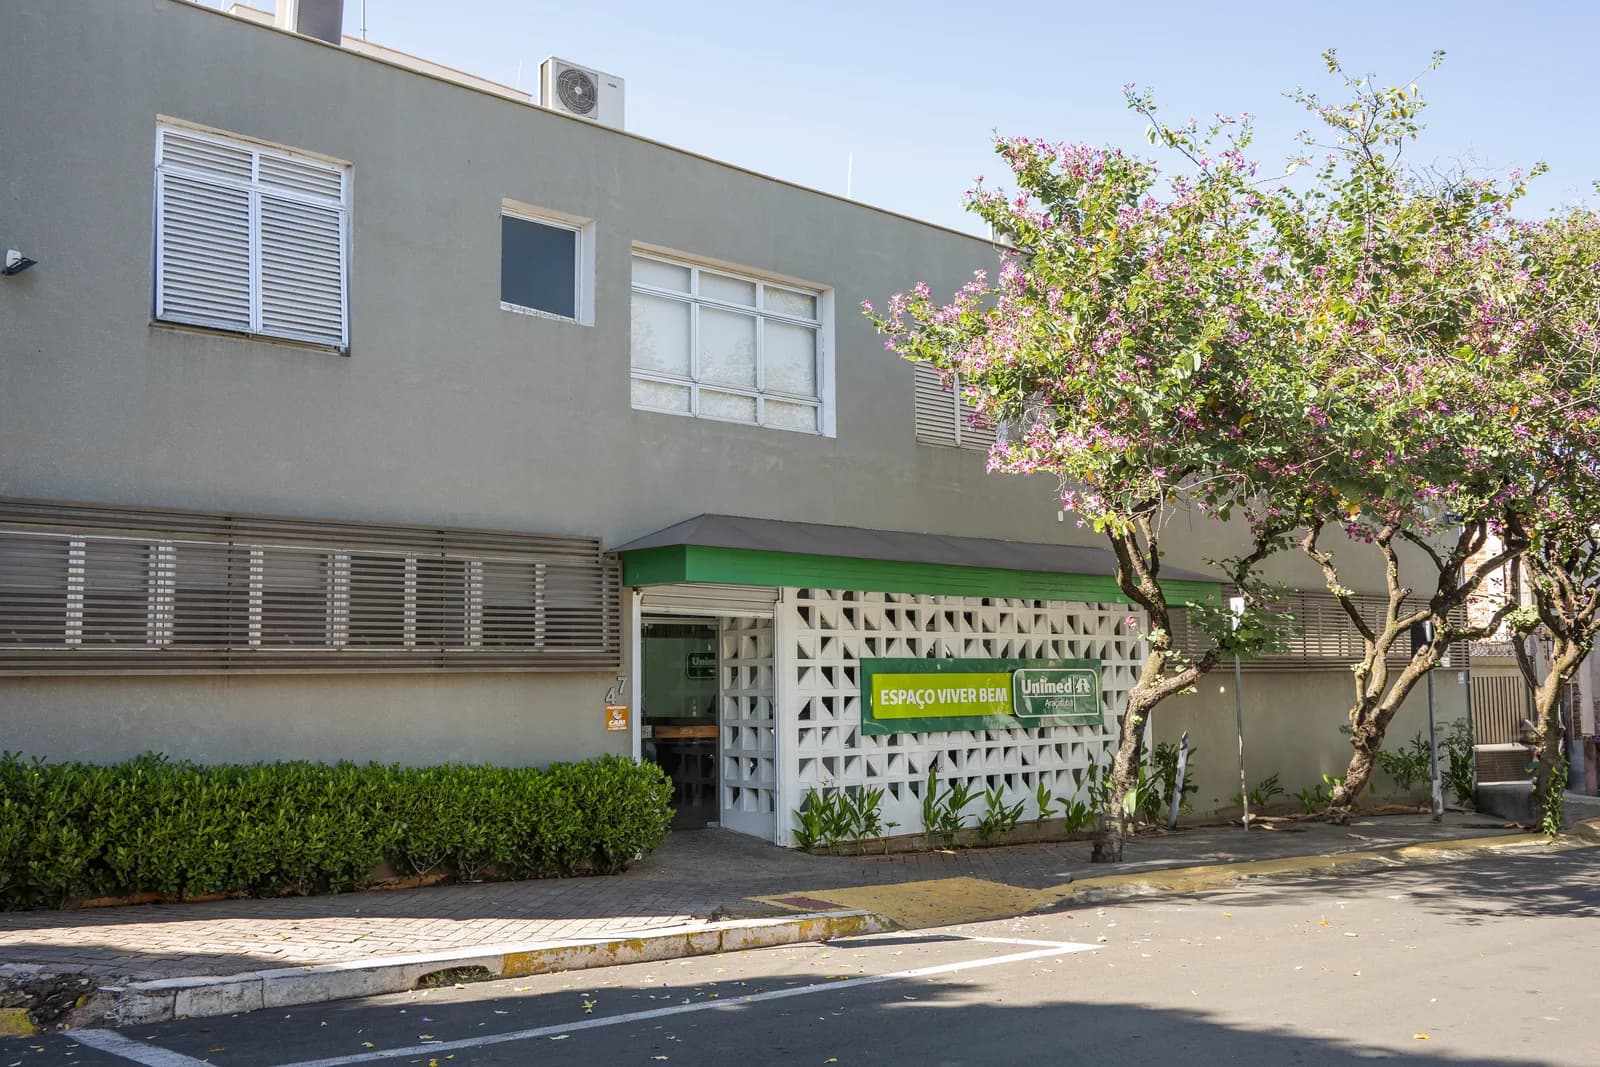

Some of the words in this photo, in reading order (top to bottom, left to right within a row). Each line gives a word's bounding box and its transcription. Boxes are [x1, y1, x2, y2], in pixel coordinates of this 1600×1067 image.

[1021, 676, 1073, 694] Unimed
[879, 688, 936, 710] ESPAÇO
[937, 687, 977, 704] VIVER
[979, 687, 1008, 703] BEM
